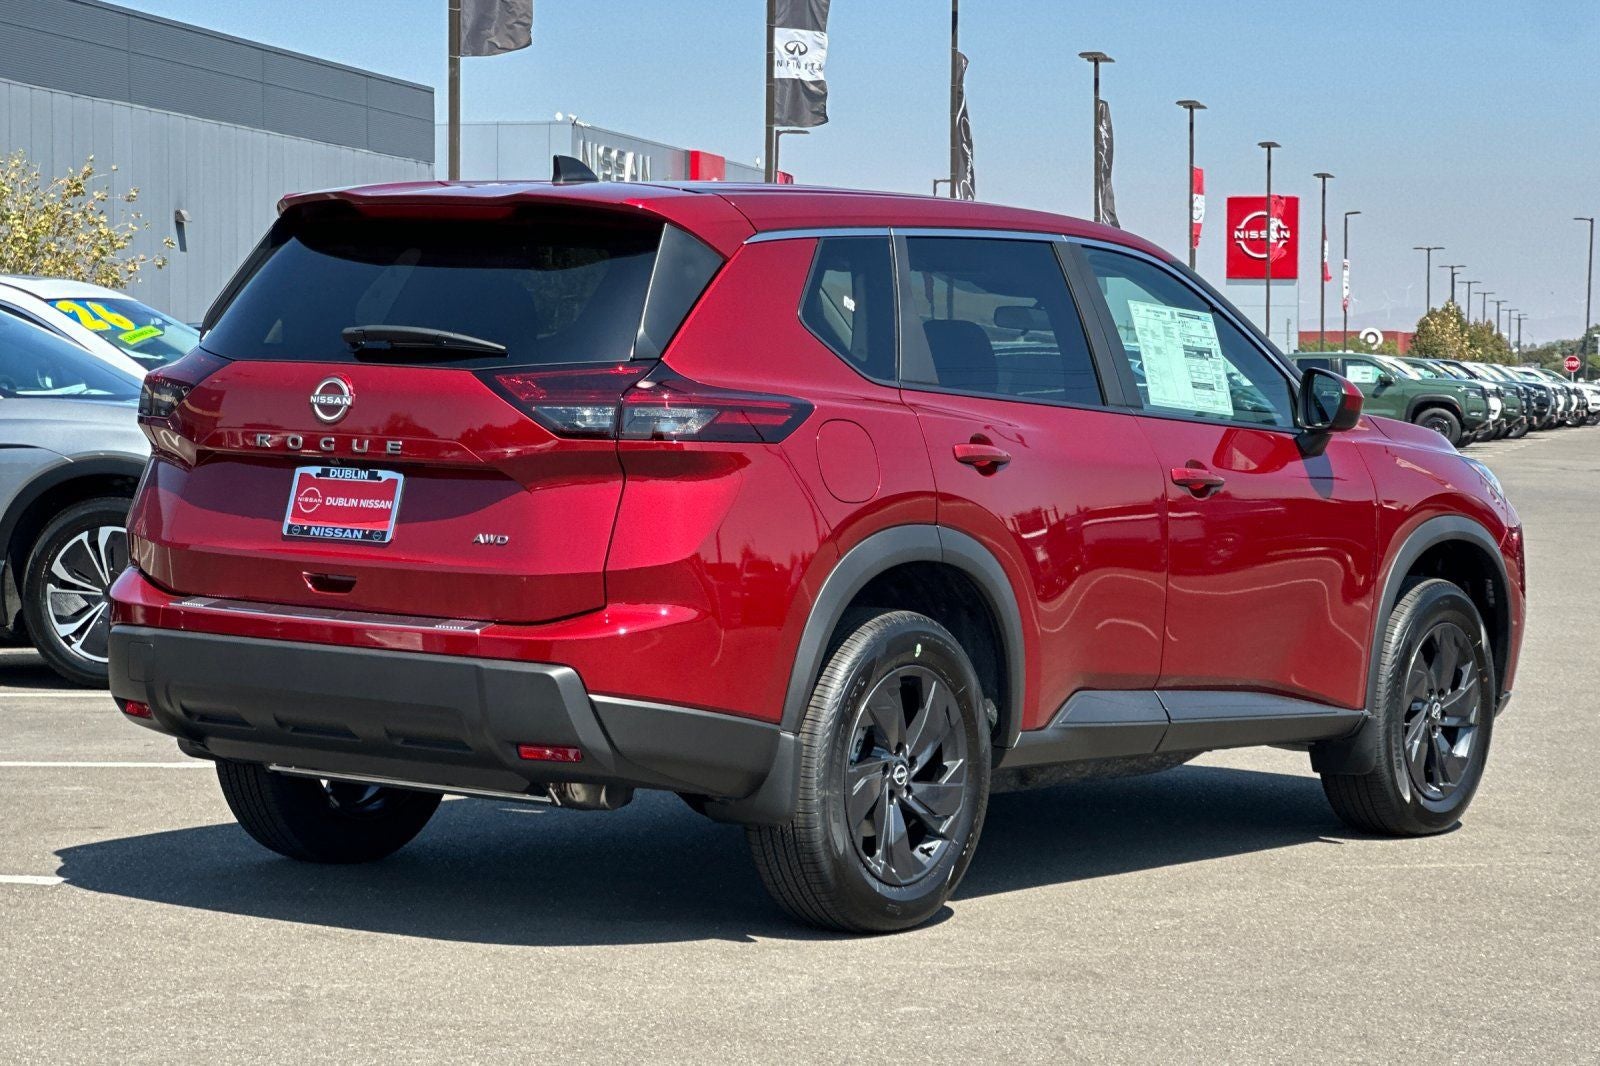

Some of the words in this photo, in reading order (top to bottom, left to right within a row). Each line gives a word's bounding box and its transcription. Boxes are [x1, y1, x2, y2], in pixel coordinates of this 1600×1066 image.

[1234, 230, 1291, 239] NISSN
[56, 300, 135, 331] 26
[1565, 360, 1579, 368] STOP
[310, 395, 351, 406] NISSAN
[256, 433, 403, 455] ROGUE
[329, 468, 369, 480] DUBLIN
[298, 496, 322, 504] NISSAN
[325, 496, 358, 508] DUBLIN
[359, 499, 393, 510] NISSAN
[310, 526, 363, 539] NISSAN
[472, 532, 510, 546] AWD
